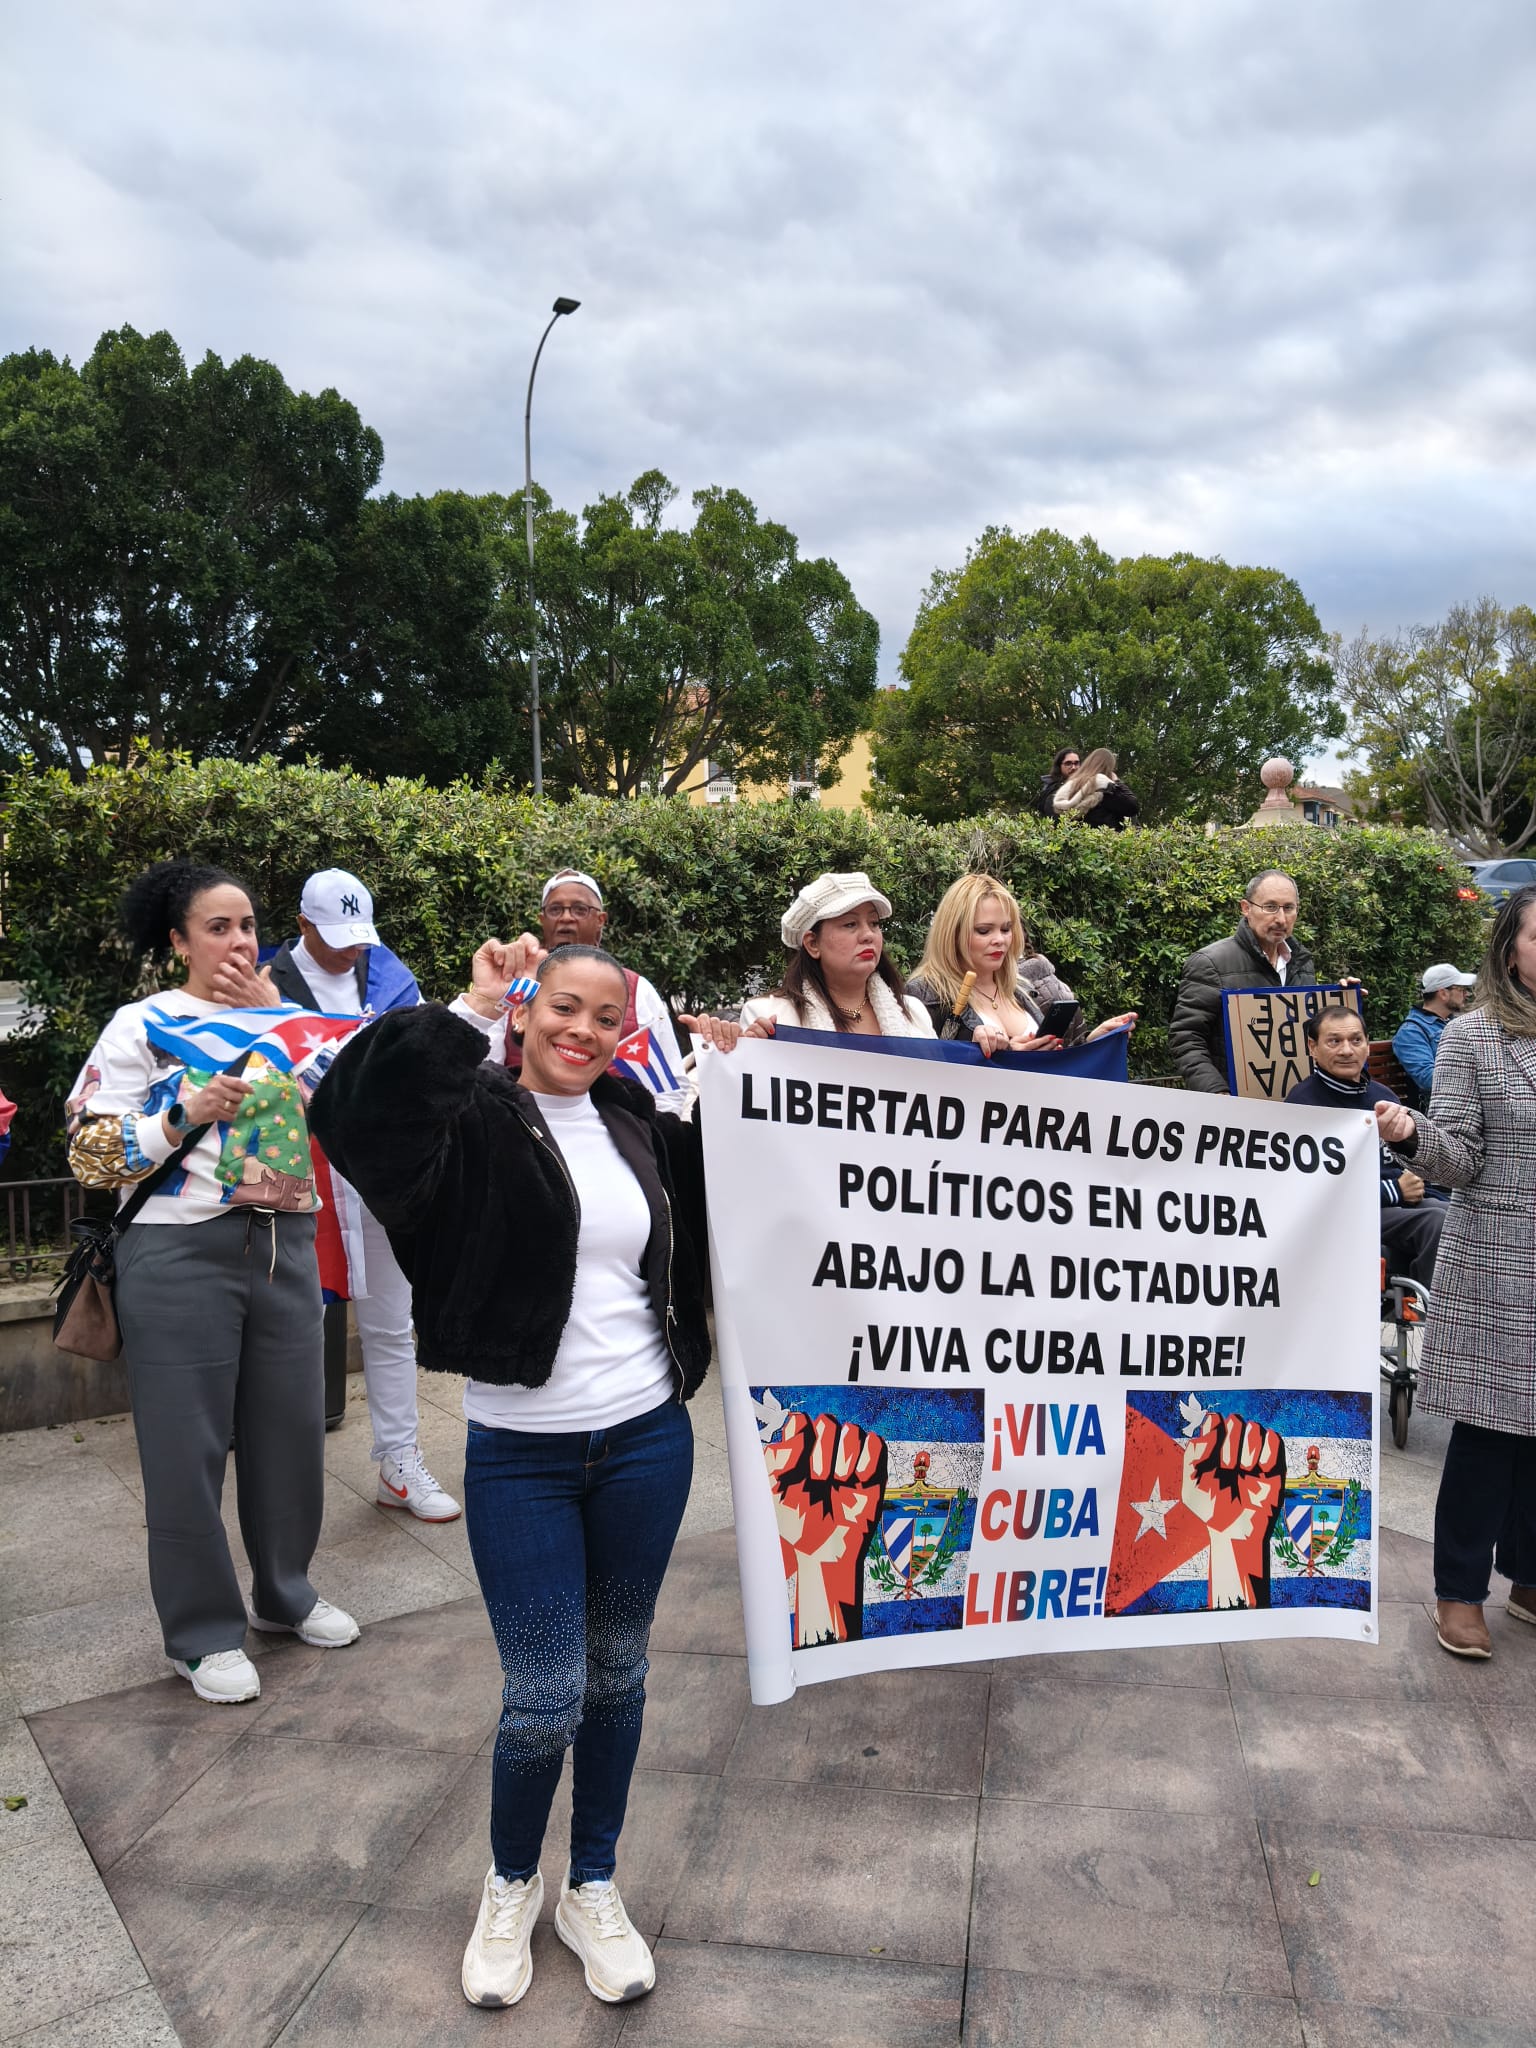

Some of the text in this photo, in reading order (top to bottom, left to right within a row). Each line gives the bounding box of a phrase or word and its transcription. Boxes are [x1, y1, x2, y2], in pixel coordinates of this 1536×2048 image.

[741, 1073, 1346, 1176] LIBERTAD PARA LOS PRESOS
[839, 1160, 1267, 1239] POLÍTICOS EN CUBA
[811, 1241, 1281, 1308] ABAJO LA DICTADURA
[847, 1324, 1247, 1382] ¡VIVA CUBA LIBRE!
[991, 1403, 1107, 1472] ¡VIVA
[980, 1487, 1101, 1542] CUBA
[965, 1566, 1108, 1626] LIBRE!
